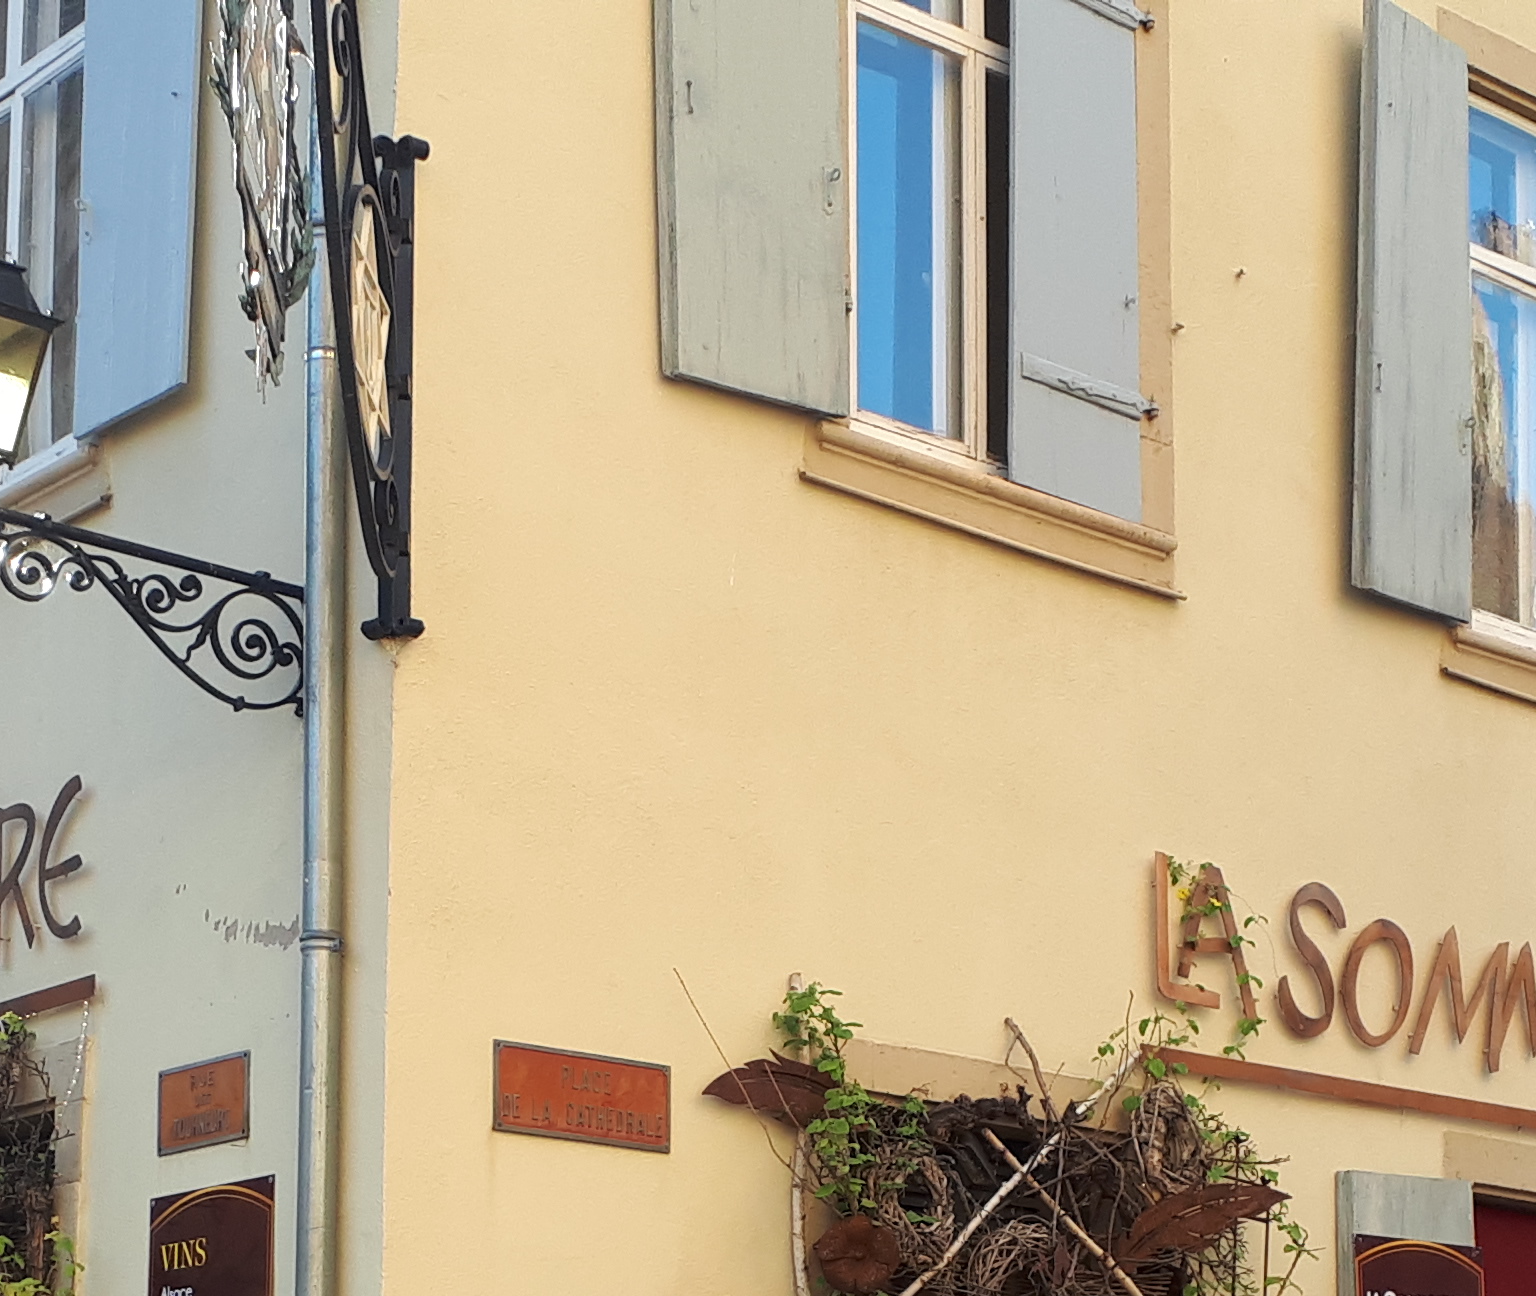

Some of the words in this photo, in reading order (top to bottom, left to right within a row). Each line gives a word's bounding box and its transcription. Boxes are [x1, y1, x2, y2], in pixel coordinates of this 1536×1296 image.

[1153, 851, 1258, 1022] LA
[561, 1064, 612, 1096] PLACE
[501, 1093, 521, 1119] DE
[531, 1097, 551, 1123] LA
[160, 1237, 207, 1271] VINS
